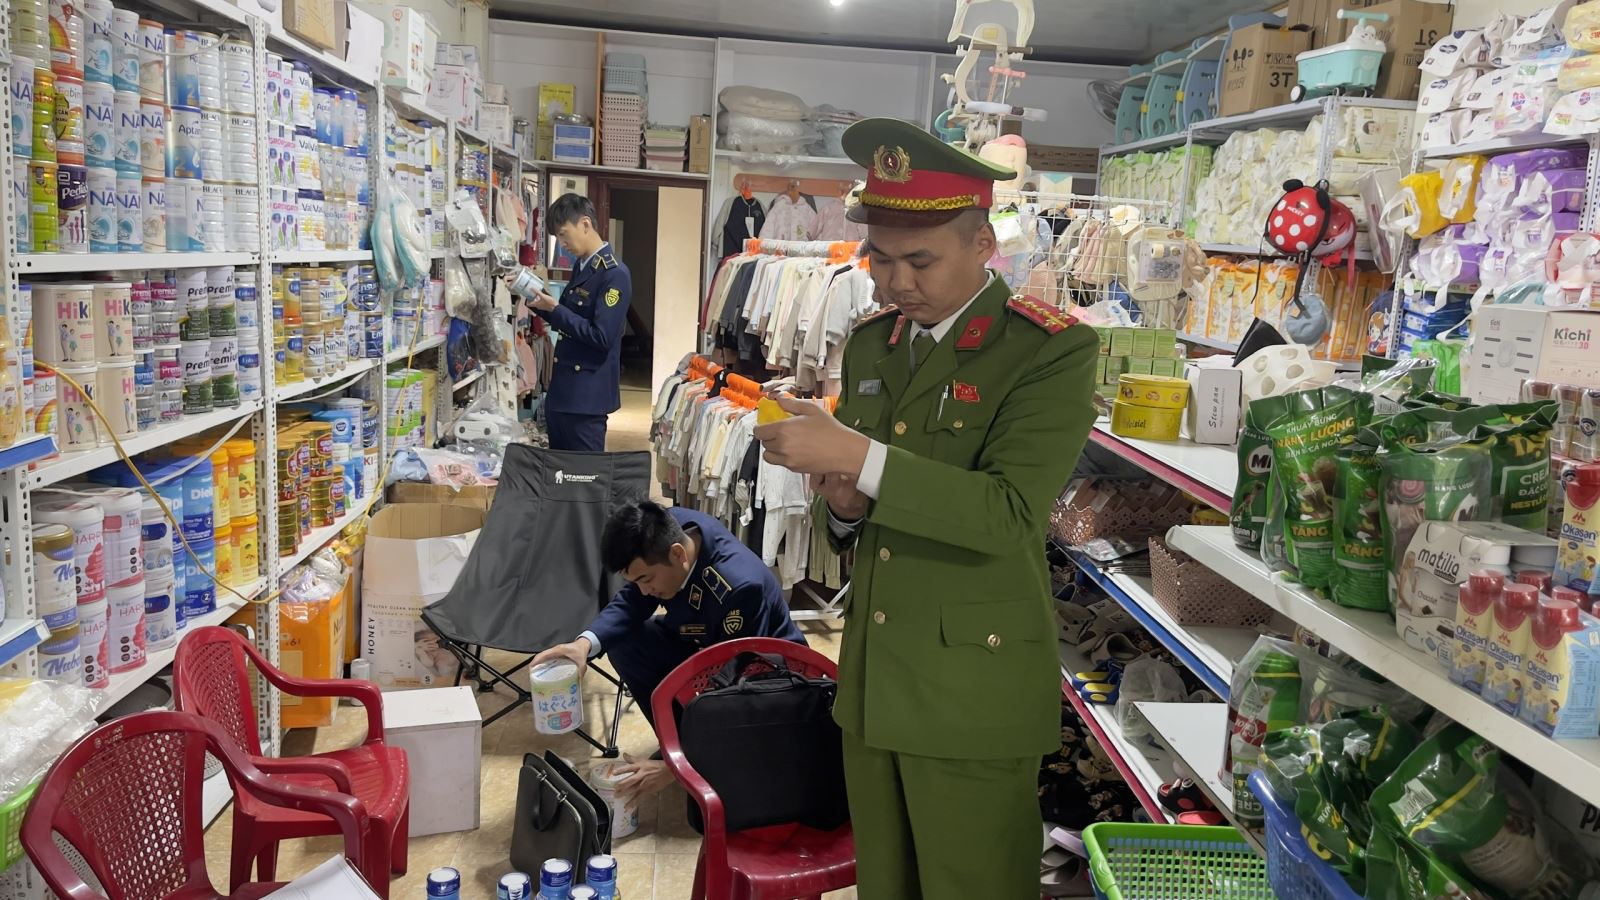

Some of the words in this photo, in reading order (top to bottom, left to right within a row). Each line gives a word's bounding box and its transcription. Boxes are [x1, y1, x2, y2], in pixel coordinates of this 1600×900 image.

[1270, 72, 1294, 88] 3T
[1553, 327, 1592, 341] Kichi
[1562, 522, 1596, 541] Okasan
[1418, 548, 1460, 577] matilia
[1456, 625, 1488, 645] Okasan
[1489, 642, 1521, 664] Okasan
[1527, 660, 1560, 684] Okasan
